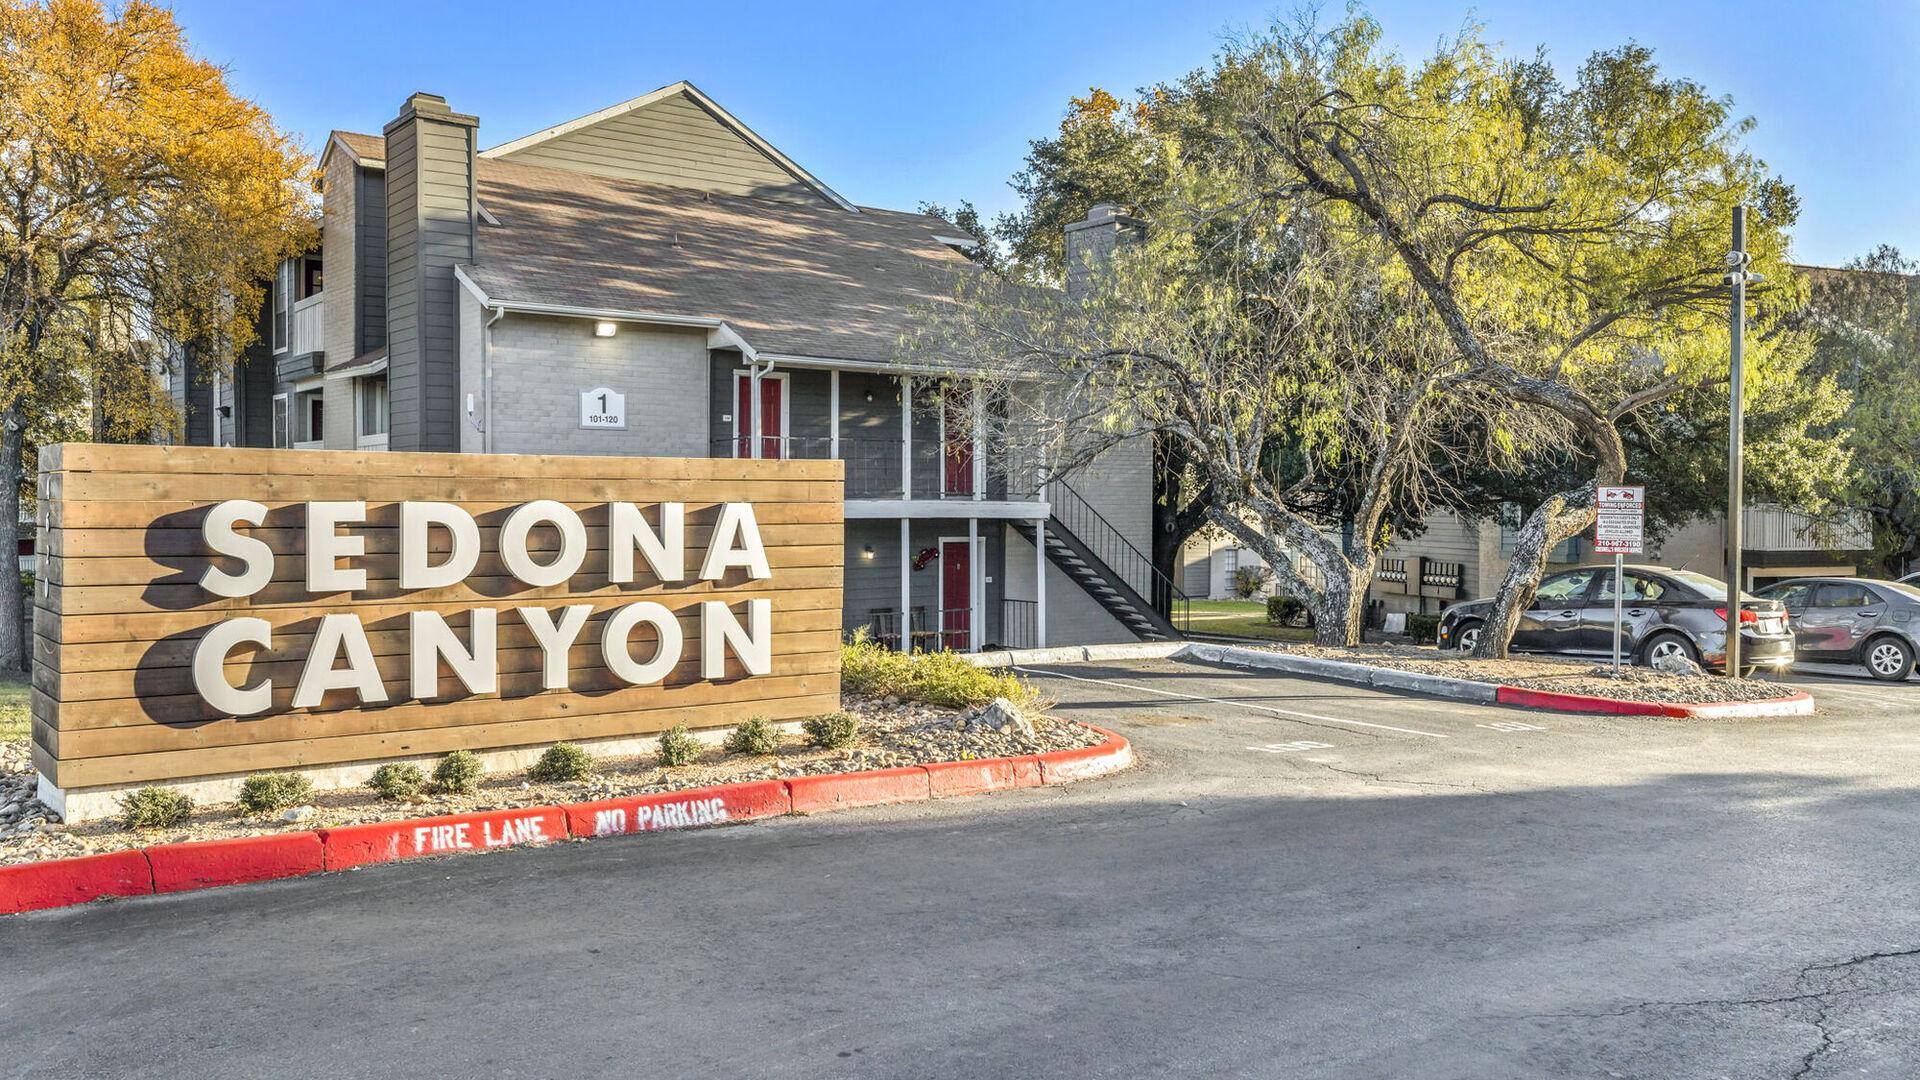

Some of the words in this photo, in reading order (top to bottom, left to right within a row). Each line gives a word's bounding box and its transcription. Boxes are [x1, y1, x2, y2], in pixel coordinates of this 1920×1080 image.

[589, 415, 619, 424] 101-120
[597, 393, 607, 414] 1
[199, 499, 772, 597] SEDONA
[192, 598, 772, 715] CANYON
[413, 822, 473, 853] FIRE
[483, 816, 549, 847] LANE
[593, 808, 627, 836] NO
[636, 797, 728, 831] PARKING
